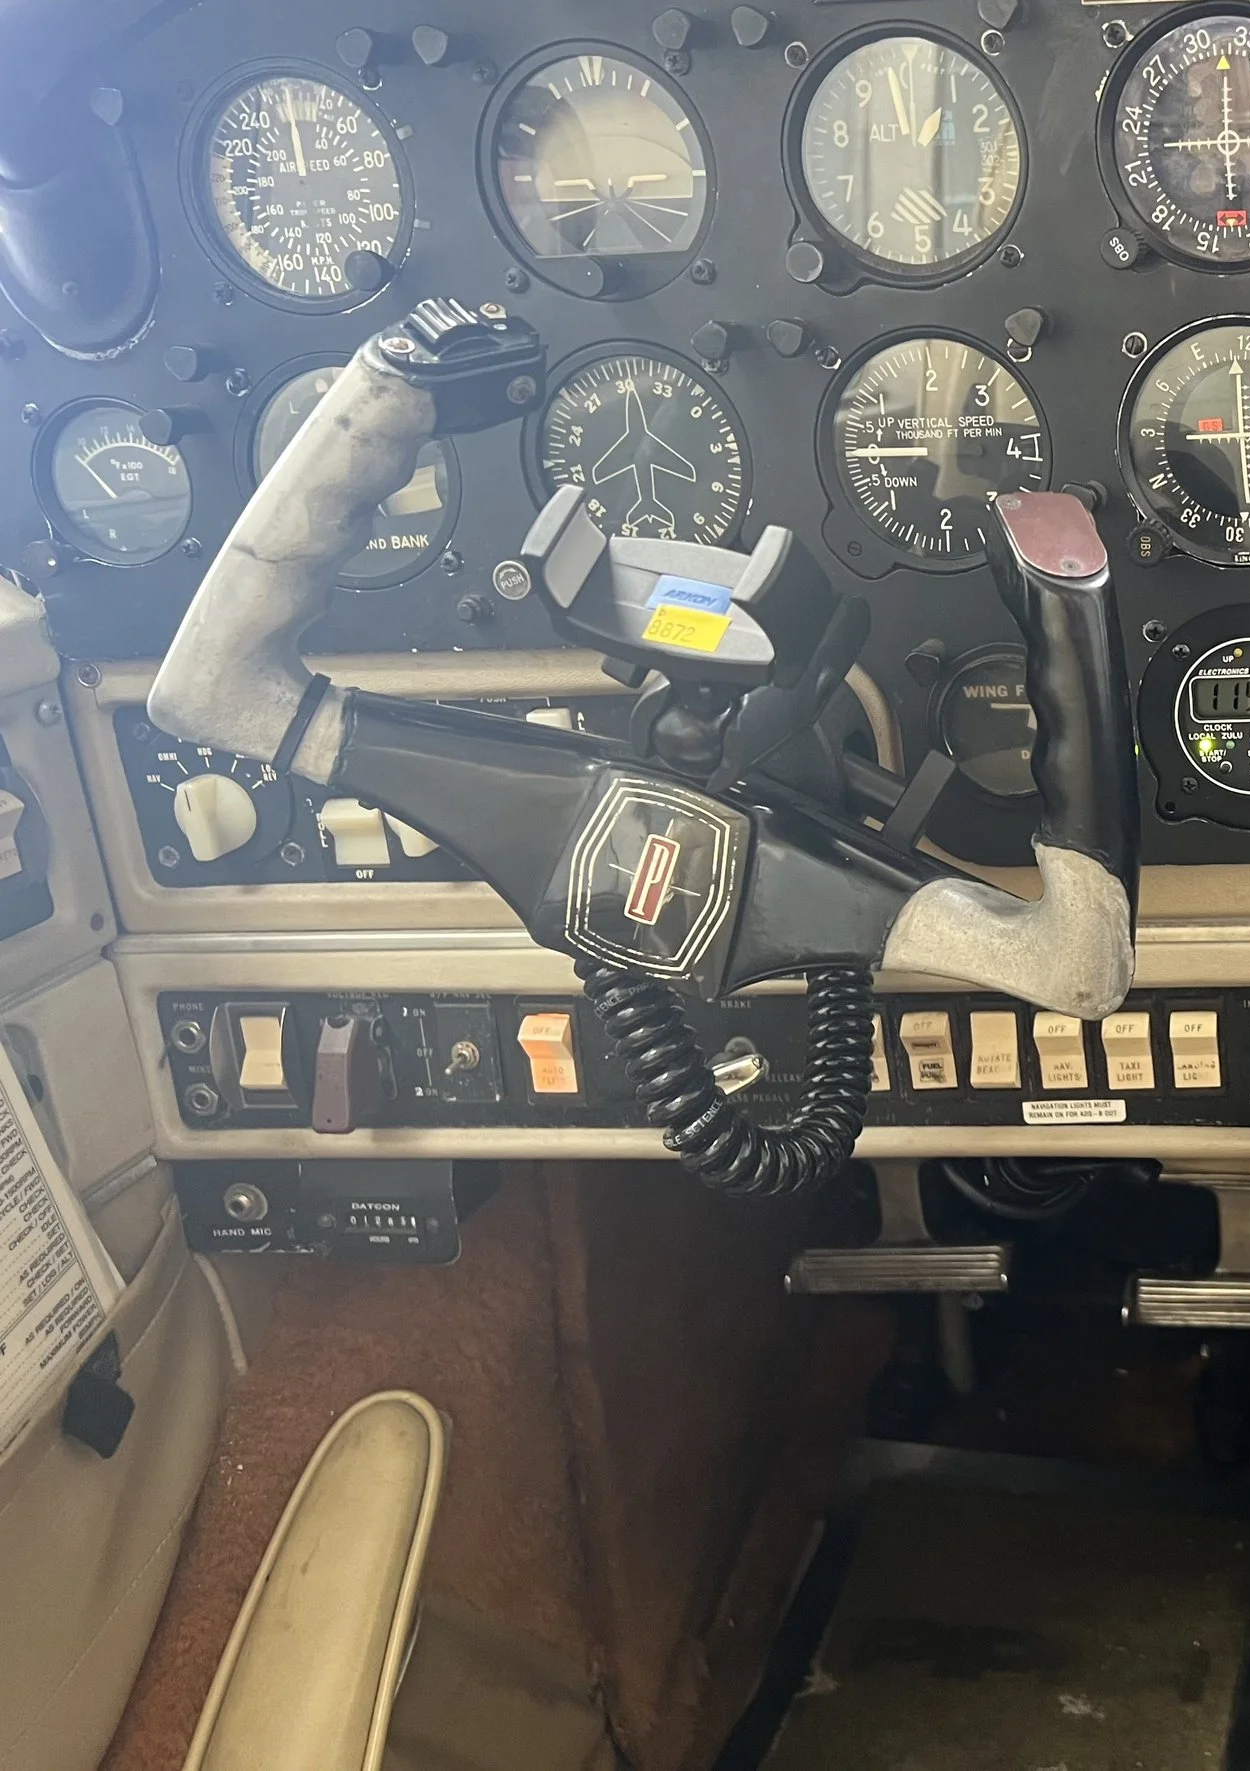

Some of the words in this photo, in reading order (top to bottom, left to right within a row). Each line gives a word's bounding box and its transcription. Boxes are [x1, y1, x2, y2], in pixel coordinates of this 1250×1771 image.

[1183, 29, 1210, 54] 30
[239, 111, 271, 130] 240
[336, 116, 357, 135] 60
[971, 103, 990, 133] 2
[832, 119, 849, 148] 8
[869, 123, 899, 143] ALT
[223, 138, 253, 157] 220
[362, 149, 385, 168] 80
[368, 203, 394, 222] 100
[1108, 236, 1130, 262] OBS
[277, 252, 303, 271] 160
[652, 381, 673, 399] 33
[879, 417, 894, 429] UP
[897, 417, 952, 430] VERTICAL
[958, 415, 994, 428] SPEED
[896, 429, 943, 440] THOUSAND
[947, 428, 958, 438] FT
[964, 428, 982, 438] PER
[985, 427, 1002, 437] MIN
[884, 476, 918, 488] DOWN
[391, 535, 430, 550] BANK
[648, 618, 697, 644] 8872
[1198, 667, 1249, 676] ELECTRONICS
[962, 685, 1008, 698] WING
[1203, 723, 1233, 732] CLOCK
[1188, 732, 1216, 741] LOCAL
[1221, 732, 1243, 740] ZULU
[355, 869, 374, 880] OFF
[1047, 1024, 1067, 1034] OFF
[1184, 1023, 1203, 1033] OFF
[1119, 1061, 1141, 1071] TAXI
[1116, 1072, 1143, 1082] LIGHT
[351, 1202, 400, 1212] DATCON
[212, 1228, 246, 1238] HAND
[250, 1227, 272, 1237] MIC
